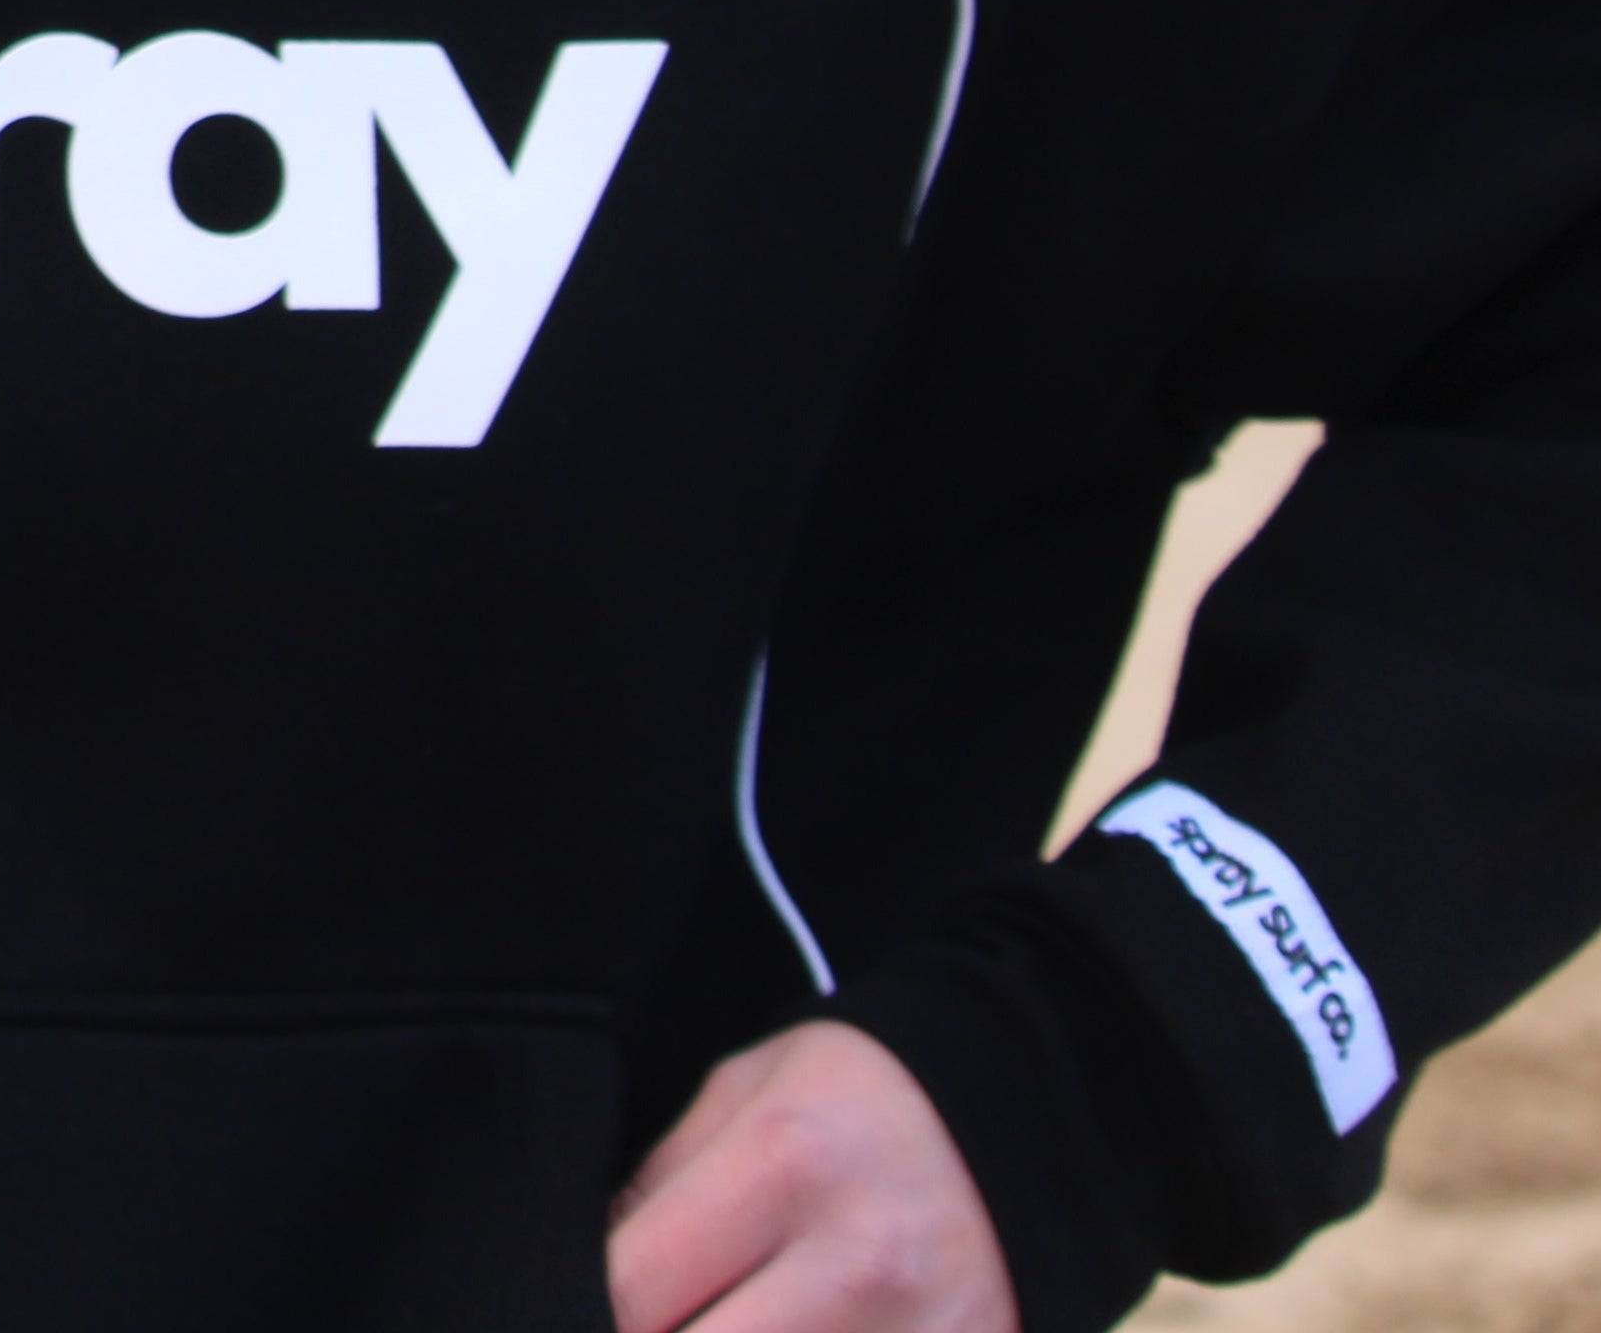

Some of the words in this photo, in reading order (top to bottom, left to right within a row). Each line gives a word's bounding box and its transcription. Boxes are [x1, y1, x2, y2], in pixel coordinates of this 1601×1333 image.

[1167, 817, 1272, 907] spray
[1259, 904, 1345, 993] surf
[1318, 993, 1354, 1060] co.
